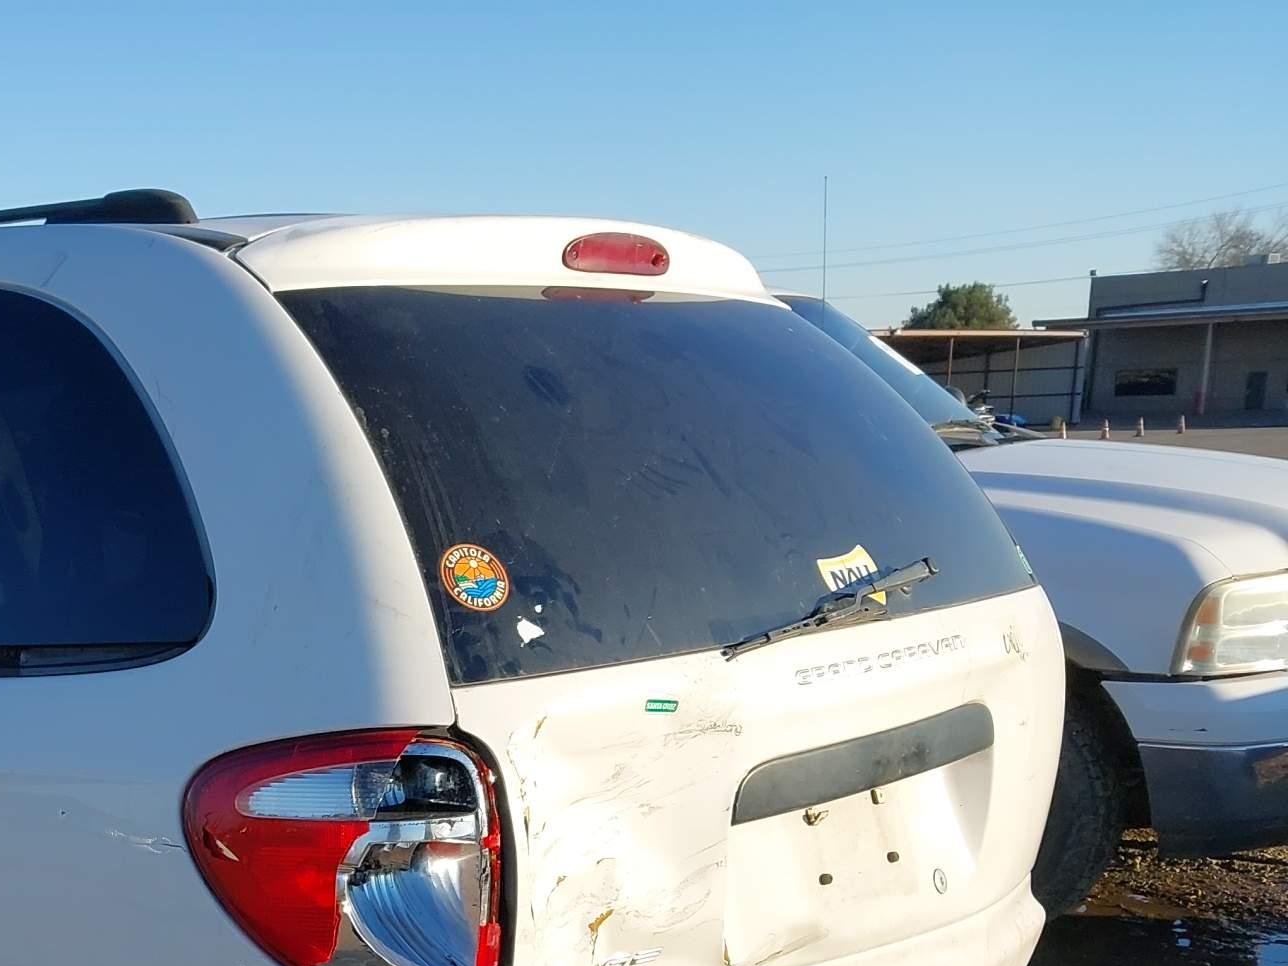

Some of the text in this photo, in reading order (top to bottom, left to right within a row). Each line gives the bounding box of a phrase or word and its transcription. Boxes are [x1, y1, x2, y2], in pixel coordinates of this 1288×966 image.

[445, 547, 490, 569] CAPITOLA
[453, 580, 506, 608] CALIFORNIA
[877, 634, 968, 669] CARAVAN
